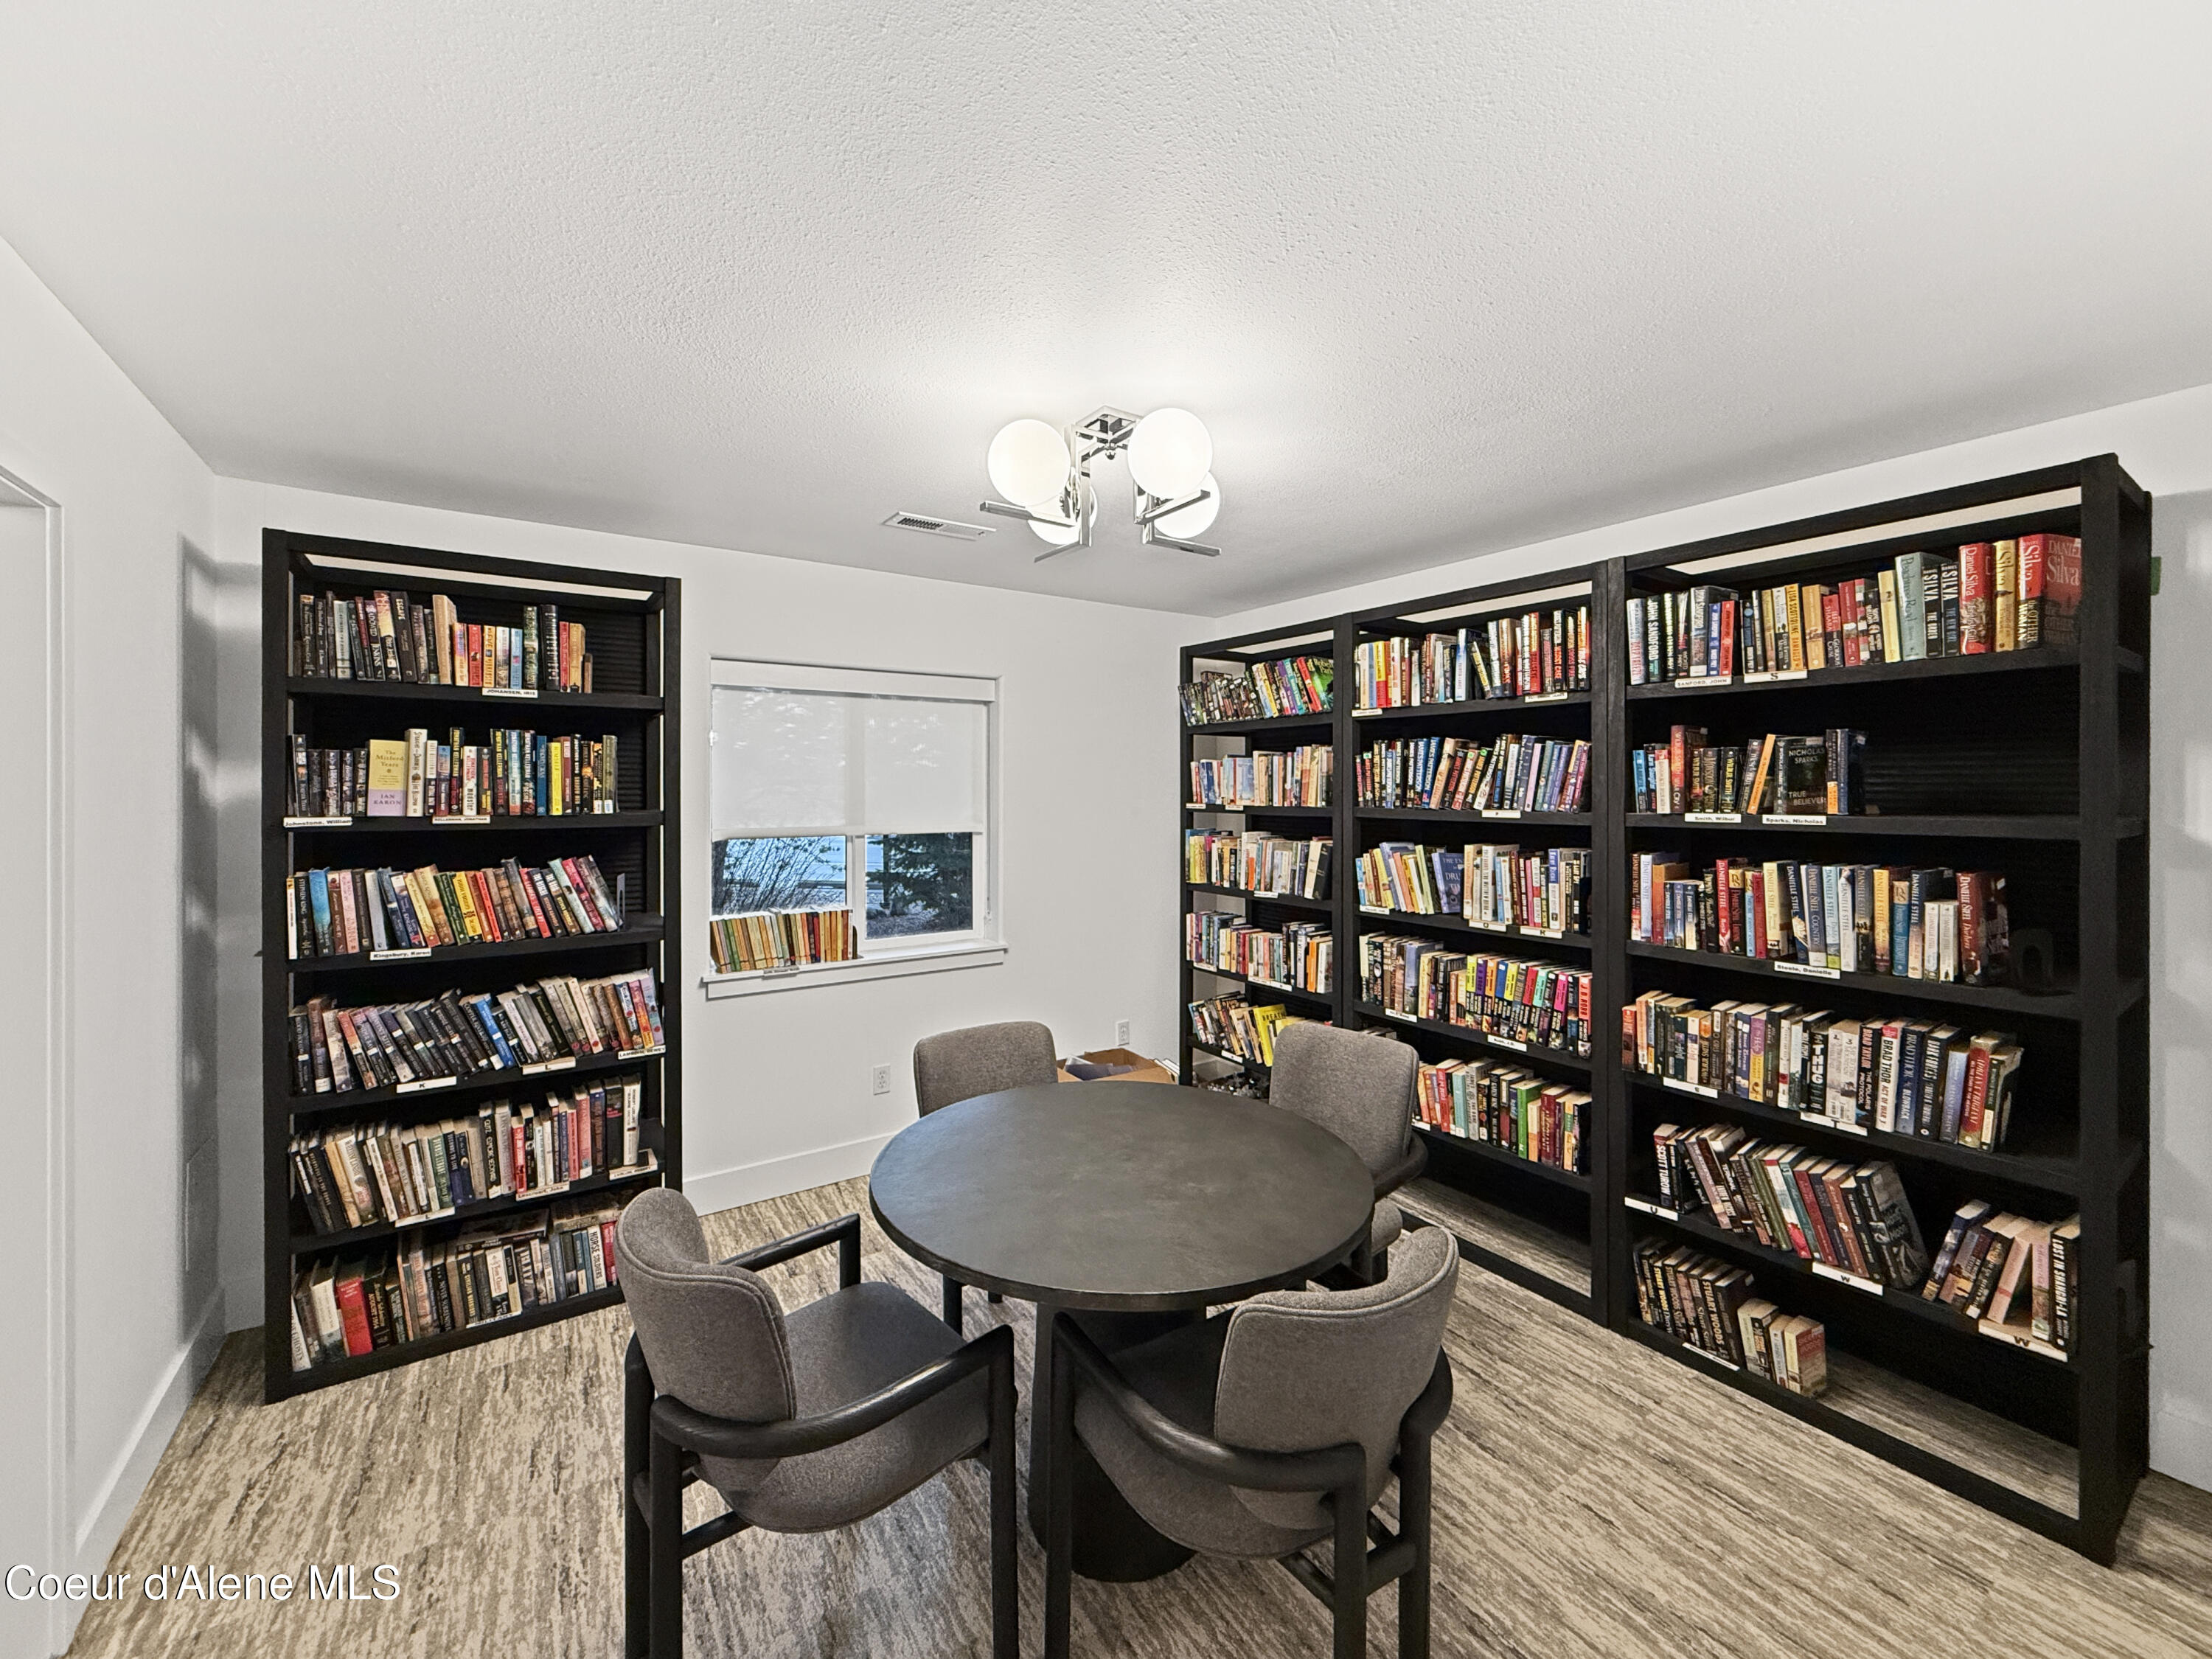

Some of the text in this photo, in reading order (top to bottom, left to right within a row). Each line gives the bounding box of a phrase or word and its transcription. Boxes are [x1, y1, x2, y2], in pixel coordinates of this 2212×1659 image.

[1966, 547, 1979, 596] Daniel Silva
[1996, 551, 2014, 586] Silva
[2023, 545, 2041, 580] Silva
[2047, 556, 2080, 585] Silva
[1924, 574, 1938, 602] SILVA
[1942, 571, 1958, 601] SILVA
[396, 599, 406, 620] ESCAPE
[1904, 599, 1917, 622] Road
[2017, 603, 2028, 641] WOMAN
[1647, 599, 1658, 661] JOHN SANDFORD
[1788, 590, 1801, 663] LISA SCOTTOLINE DAMAGED
[2027, 610, 2039, 643] OTHER
[1788, 746, 1826, 757] NICHOLAS
[1794, 756, 1818, 765] SPARKS
[1425, 757, 1434, 790] PATTERSON
[1724, 757, 1734, 796] WILBUR SMITH
[1788, 790, 1805, 800] TRUE
[285, 819, 324, 827] Johnstone,
[298, 878, 307, 900] STEPHEN
[1719, 862, 1727, 891] DANIELLE
[1767, 869, 1775, 892] DANIELLE
[1787, 866, 1800, 913] DANIELLE STEEL
[1809, 869, 1818, 894] DANIELLE
[1825, 869, 1833, 900] DANIELLE
[1857, 869, 1865, 900] DANIELLE
[1912, 874, 1920, 905] DANIELLE
[1960, 876, 1971, 903] DANIELLE
[1876, 872, 1885, 923] DANIELLE STEEL
[1961, 904, 1972, 920] STEEL
[1812, 914, 1820, 945] COUNTRY
[1777, 964, 1832, 975] Steele, Danielle
[1753, 1037, 1762, 1052] Help
[1862, 1028, 1873, 1045] BRAD
[1882, 1040, 1893, 1060] BRAD
[1860, 1046, 1872, 1068] TAYLOR
[1923, 1040, 1940, 1079] DARK FORCES
[1881, 1062, 1893, 1084] THOR
[1900, 1034, 1916, 1120] BRAD THOR BLOWBACK
[1969, 1058, 1986, 1124] ADRIANA TRIGIANI
[1879, 1105, 1888, 1118] WAR
[1656, 1144, 1672, 1195] SCOTT TUROW
[590, 1231, 602, 1279] HORSE SOLDIERS
[1654, 1267, 1664, 1291] STUART
[2052, 1239, 2068, 1317] LOST IN SHANGRI-LA
[1702, 1281, 1725, 1346] STUART WOODS
[2013, 1335, 2030, 1347] W
